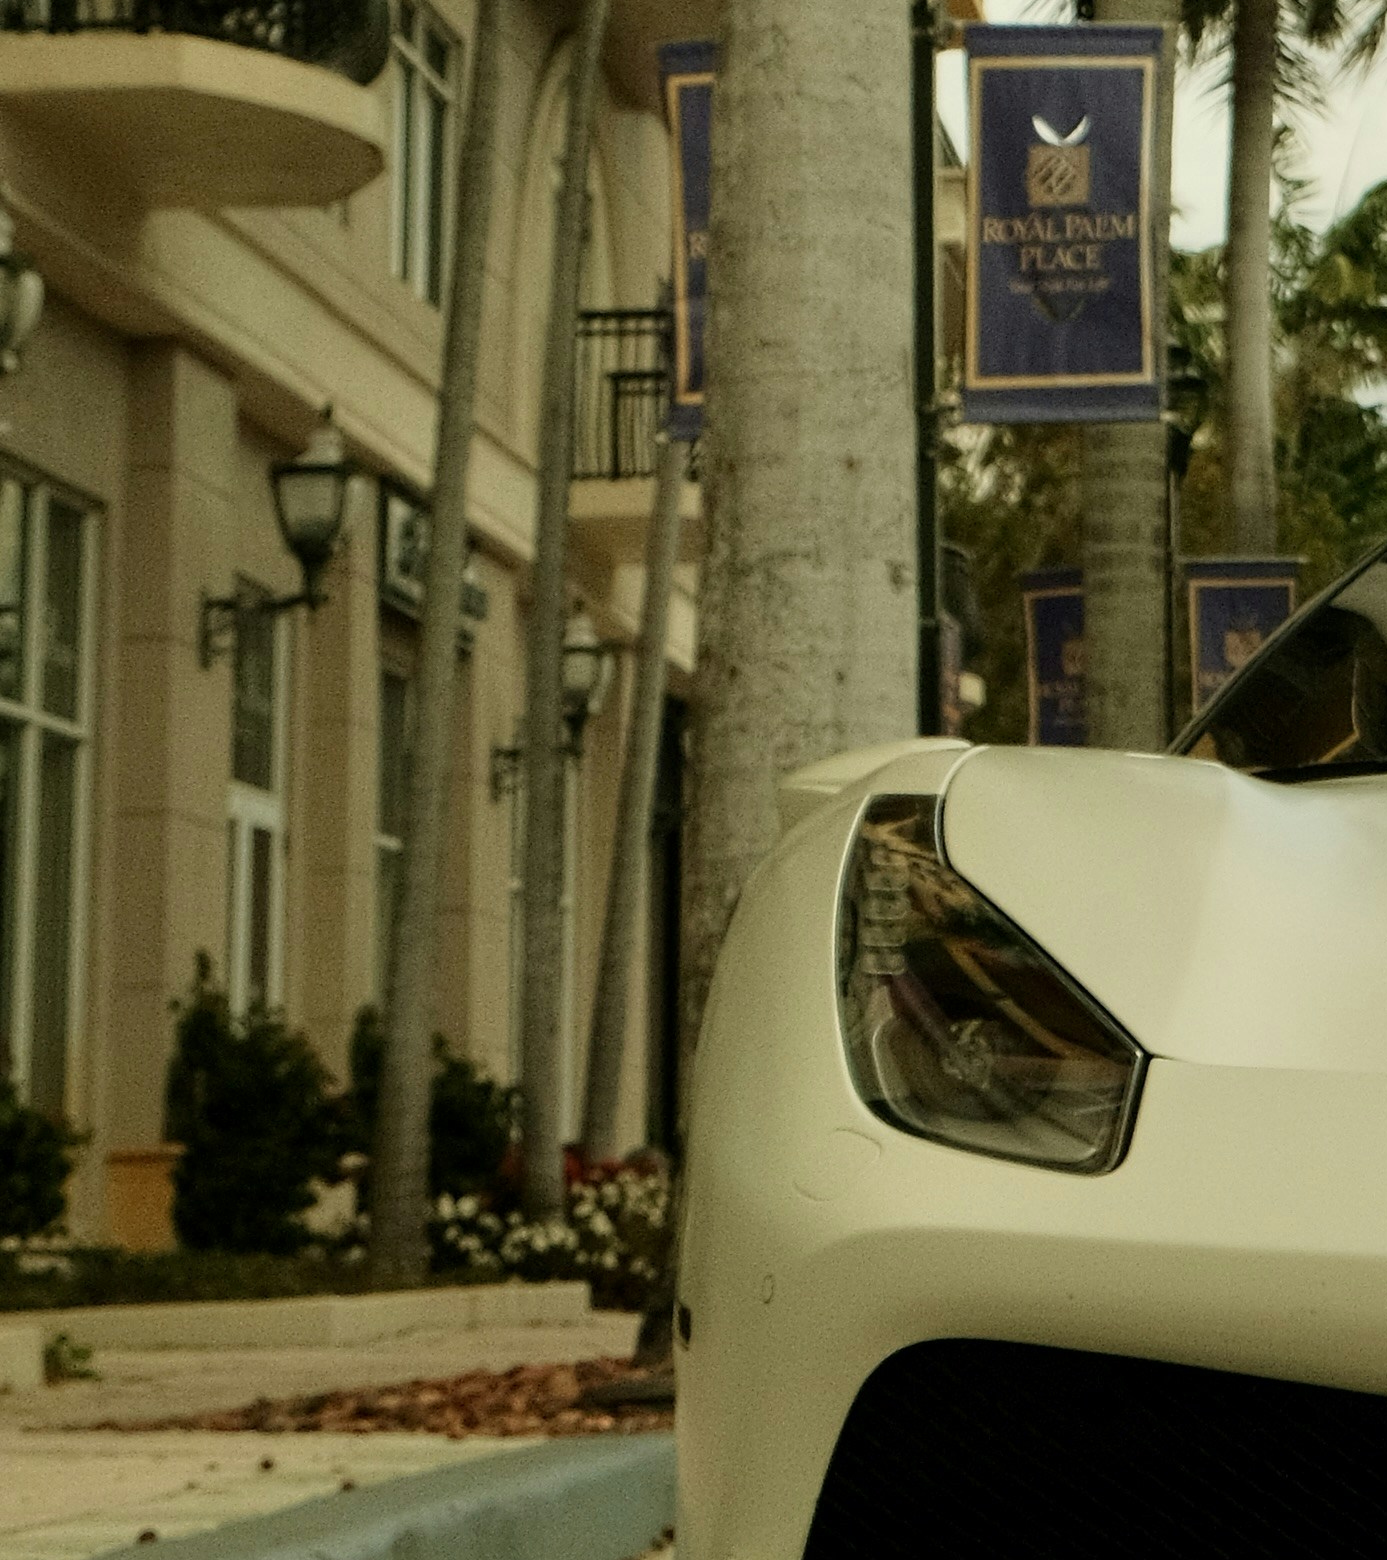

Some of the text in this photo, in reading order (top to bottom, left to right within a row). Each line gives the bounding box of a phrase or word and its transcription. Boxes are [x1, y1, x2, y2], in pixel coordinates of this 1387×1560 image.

[982, 213, 1135, 243] ROYAL PALM
[1019, 244, 1104, 271] PLACE
